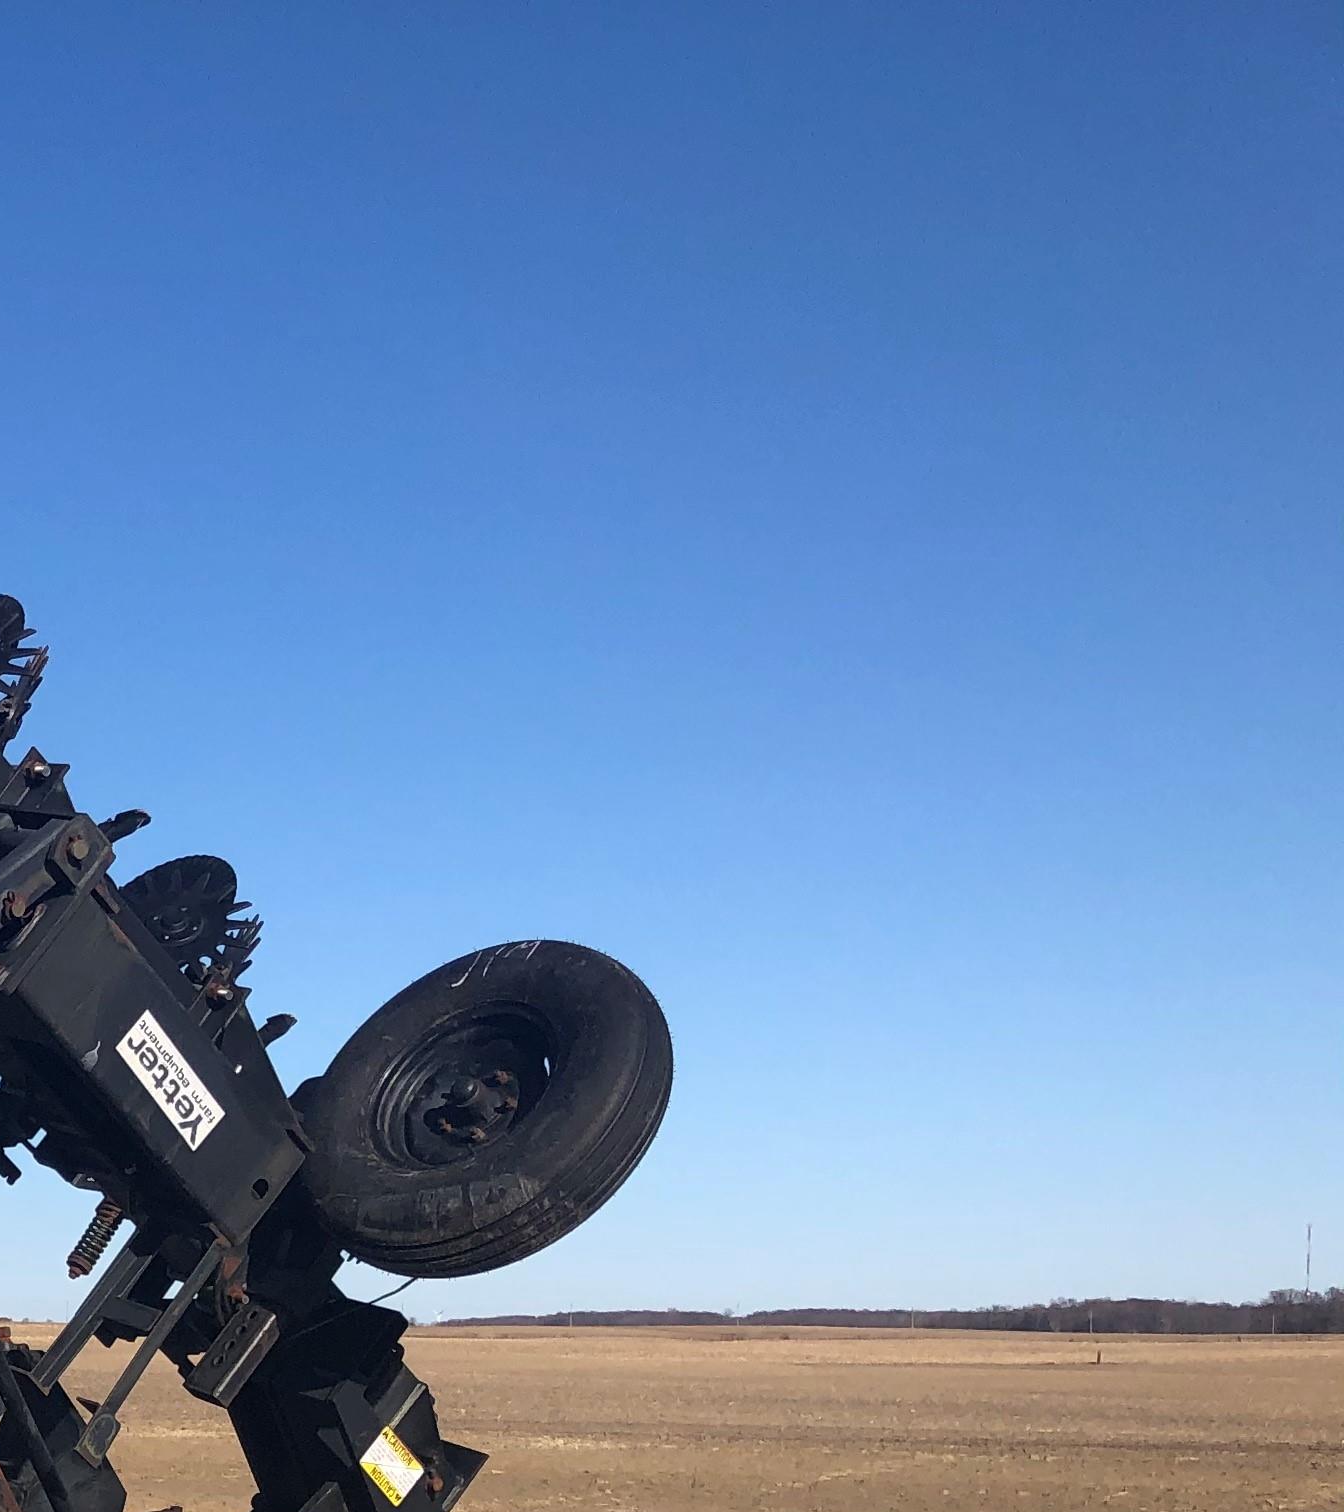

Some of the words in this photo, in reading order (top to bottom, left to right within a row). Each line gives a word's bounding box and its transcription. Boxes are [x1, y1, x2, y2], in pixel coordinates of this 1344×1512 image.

[138, 1019, 190, 1088] equipment
[126, 1034, 205, 1146] Yetter
[191, 1091, 216, 1124] farm
[387, 1435, 413, 1466] CAUTION
[370, 1467, 397, 1497] CAUTION
